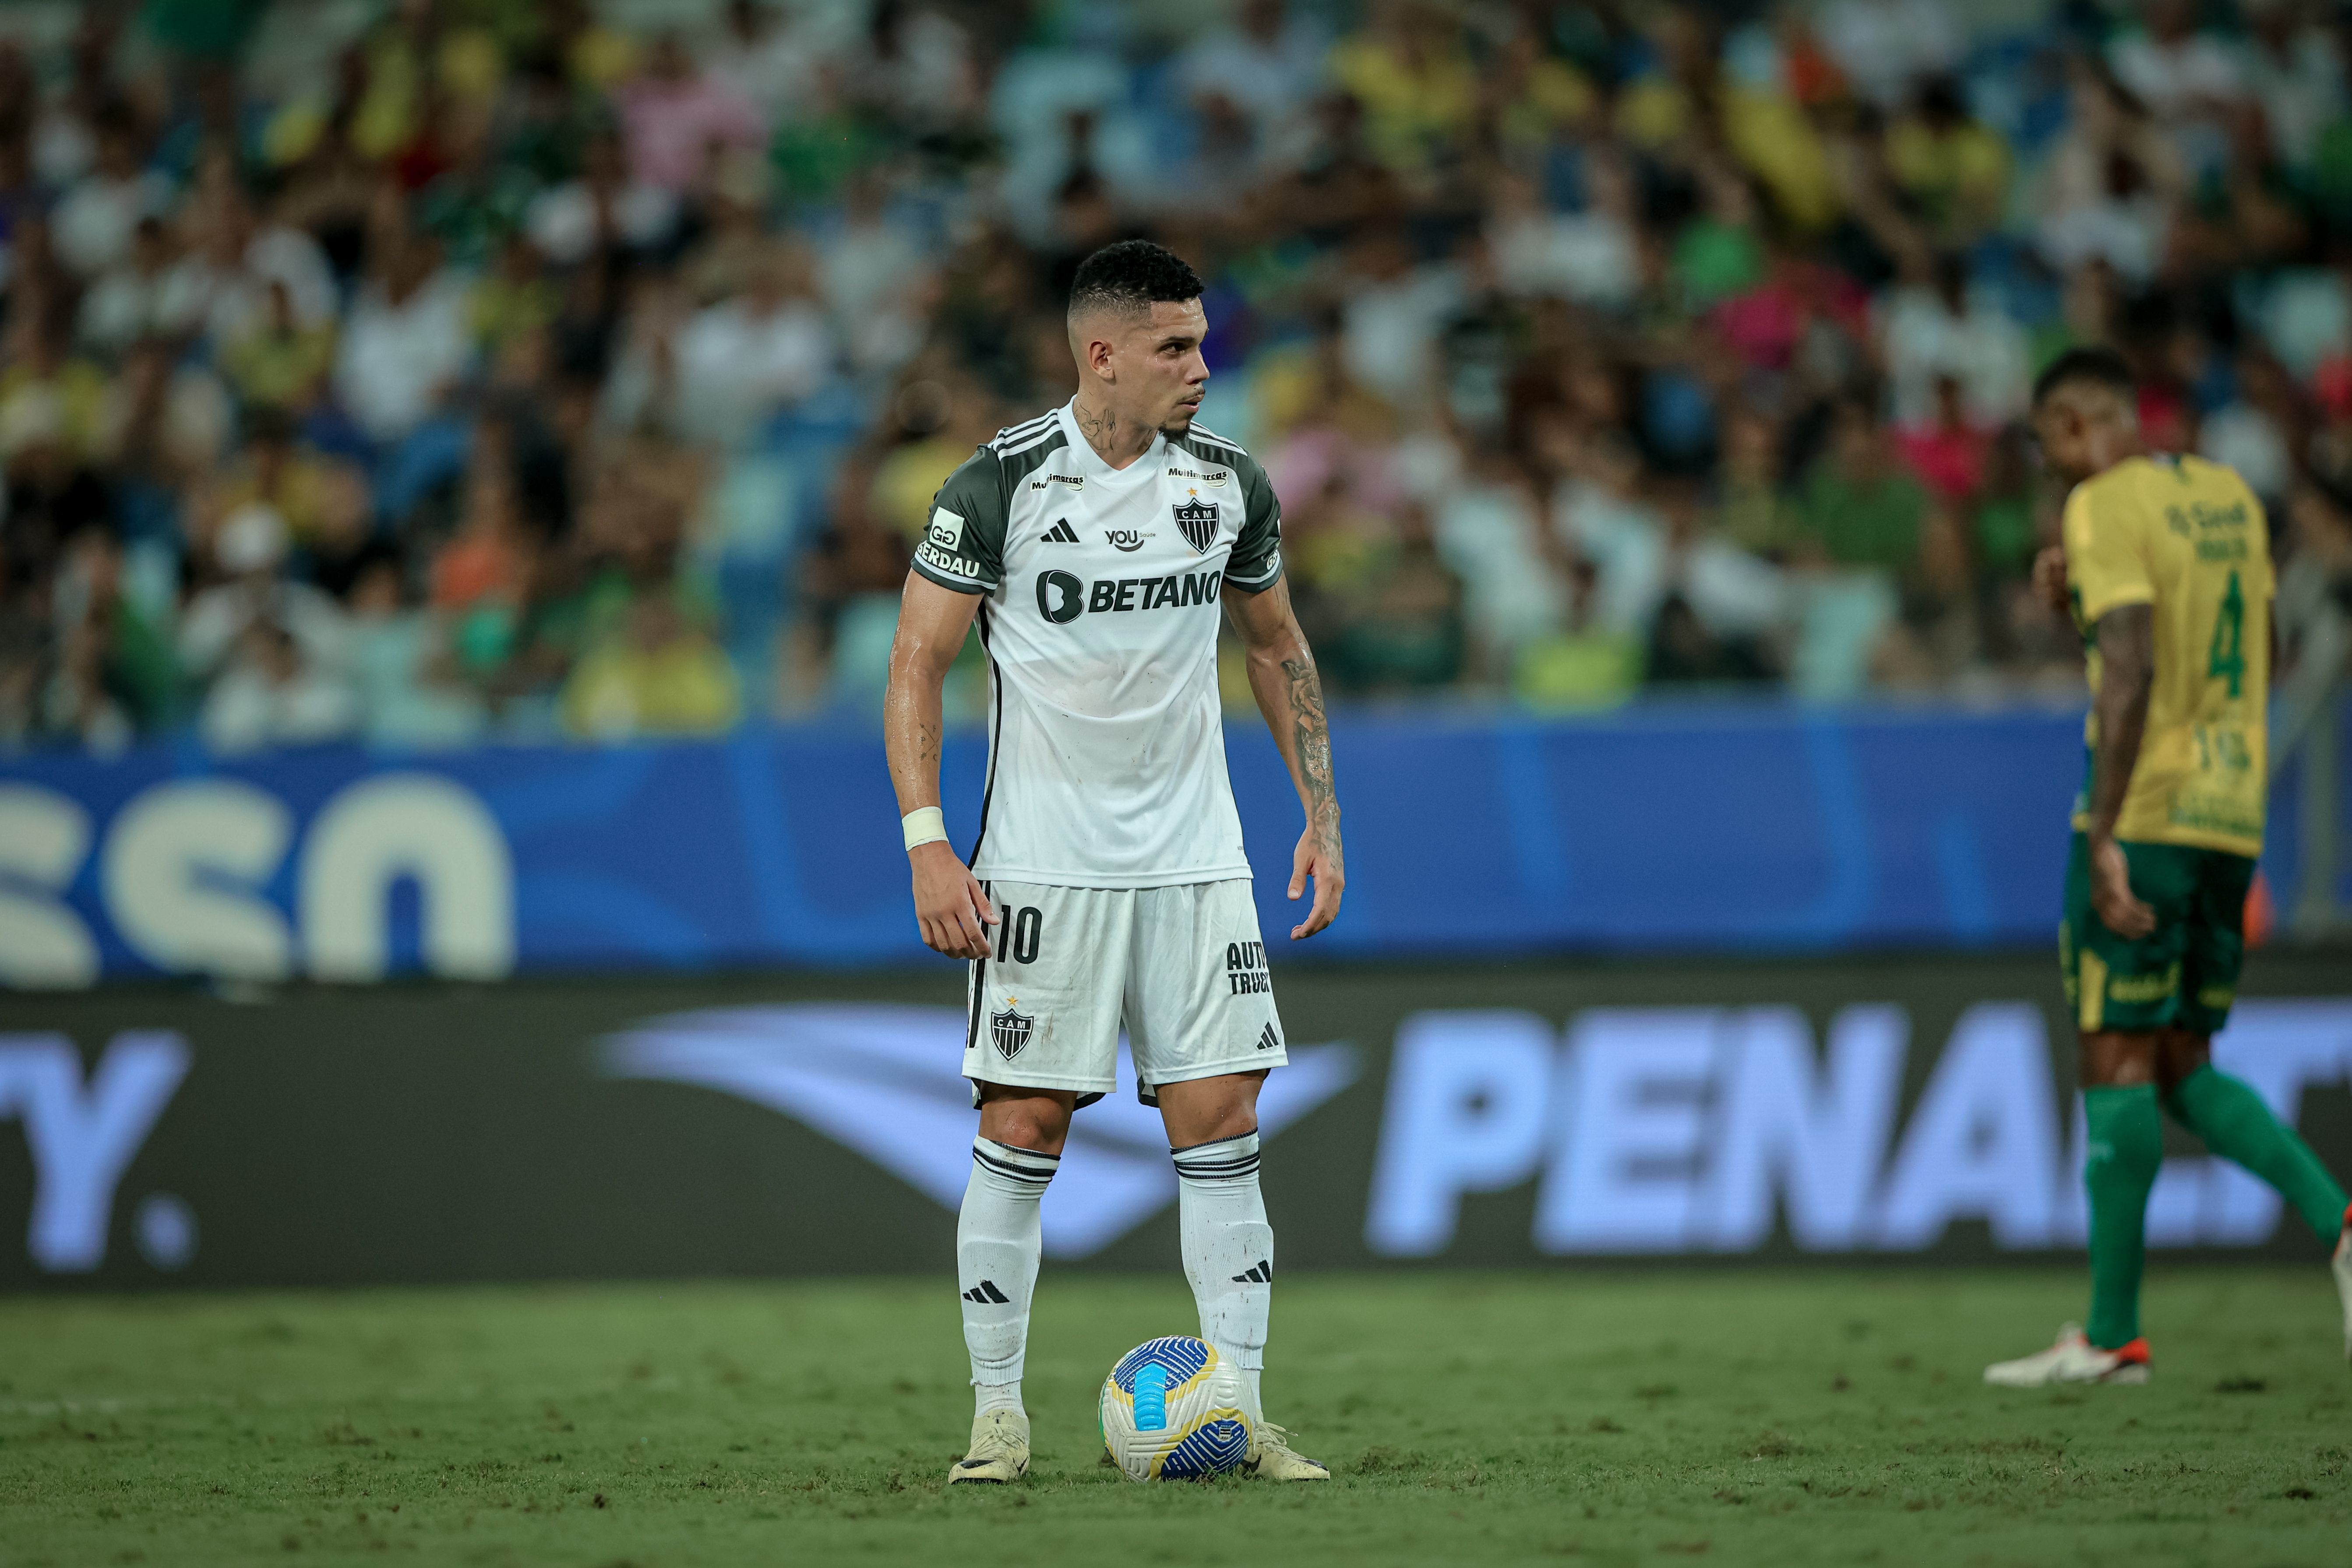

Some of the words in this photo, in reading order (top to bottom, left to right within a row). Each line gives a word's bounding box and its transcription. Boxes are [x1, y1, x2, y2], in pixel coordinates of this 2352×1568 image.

[1168, 468, 1227, 480] Multimarcas
[1032, 473, 1083, 490] Mutimarcas
[1182, 511, 1212, 519] CAM
[1104, 530, 1138, 544] YOU
[1088, 571, 1221, 613] BETANO
[998, 904, 1043, 964] 10
[997, 1019, 1026, 1029] CAM
